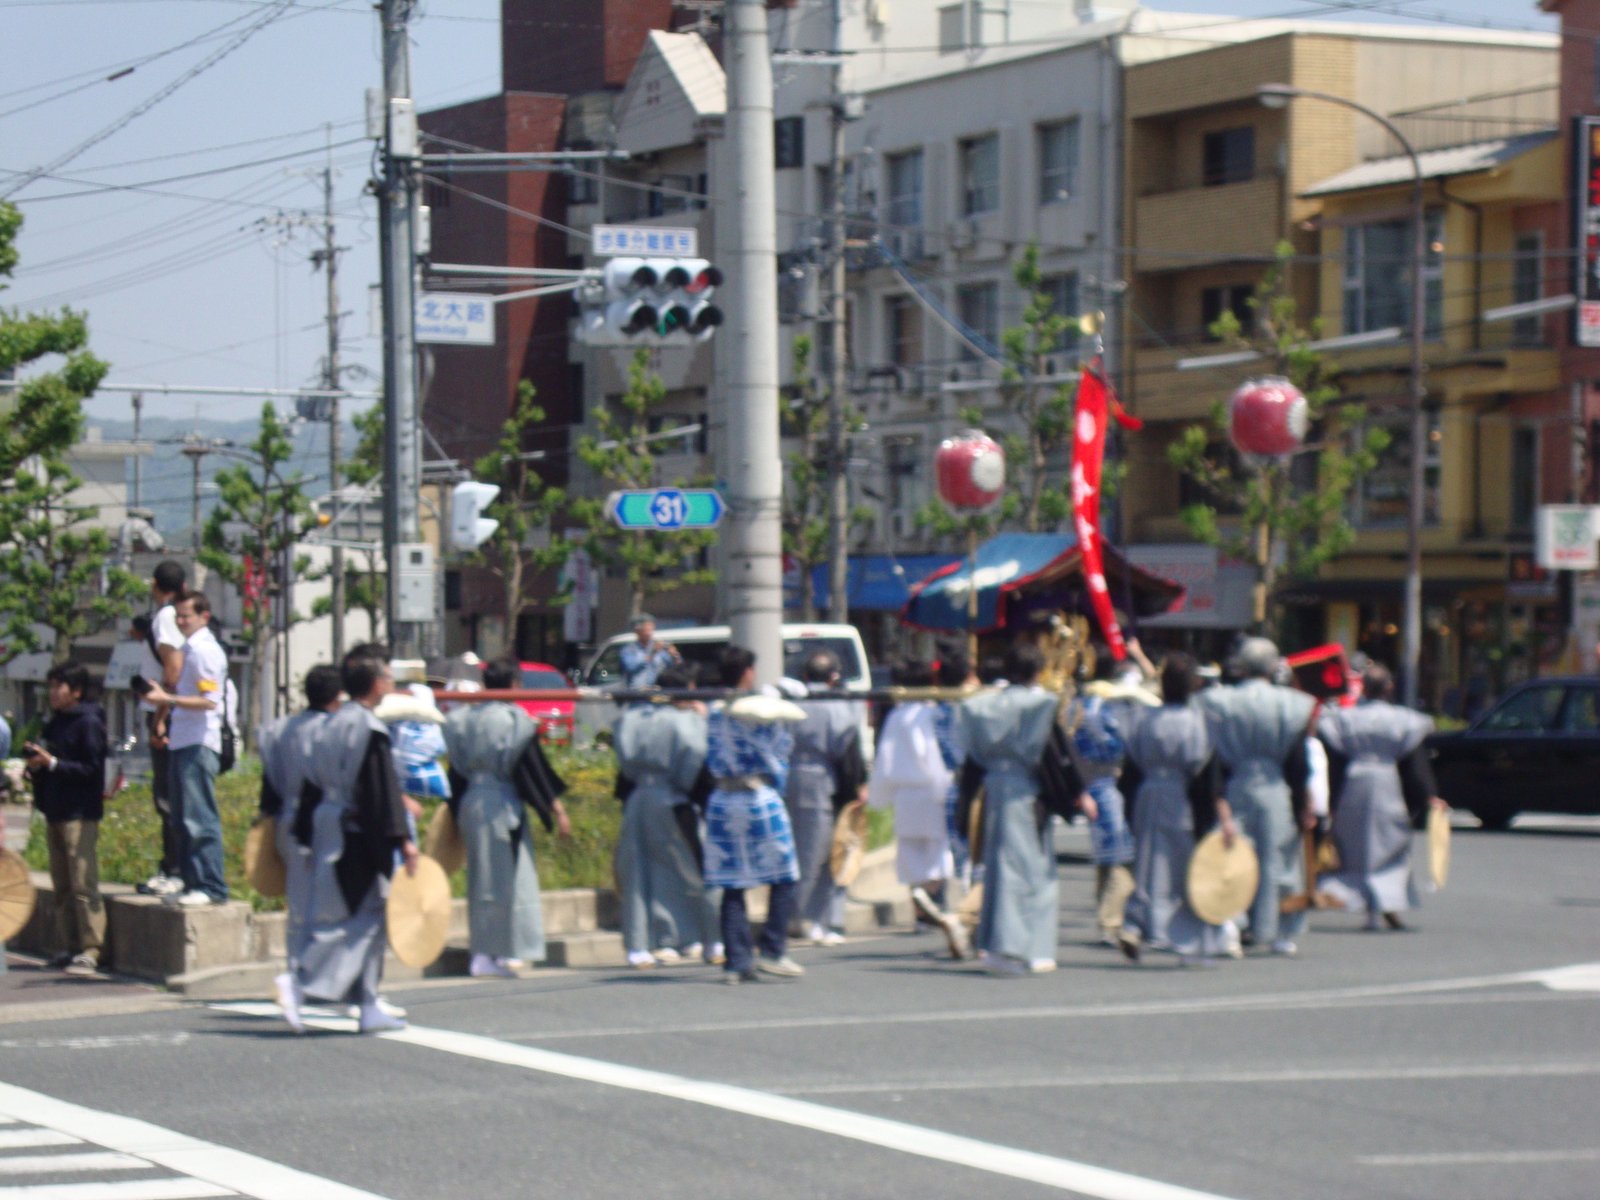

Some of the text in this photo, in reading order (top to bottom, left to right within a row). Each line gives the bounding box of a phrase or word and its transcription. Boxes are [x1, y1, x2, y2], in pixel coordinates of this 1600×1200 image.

[418, 301, 485, 322] 北大路
[655, 495, 683, 524] 31
